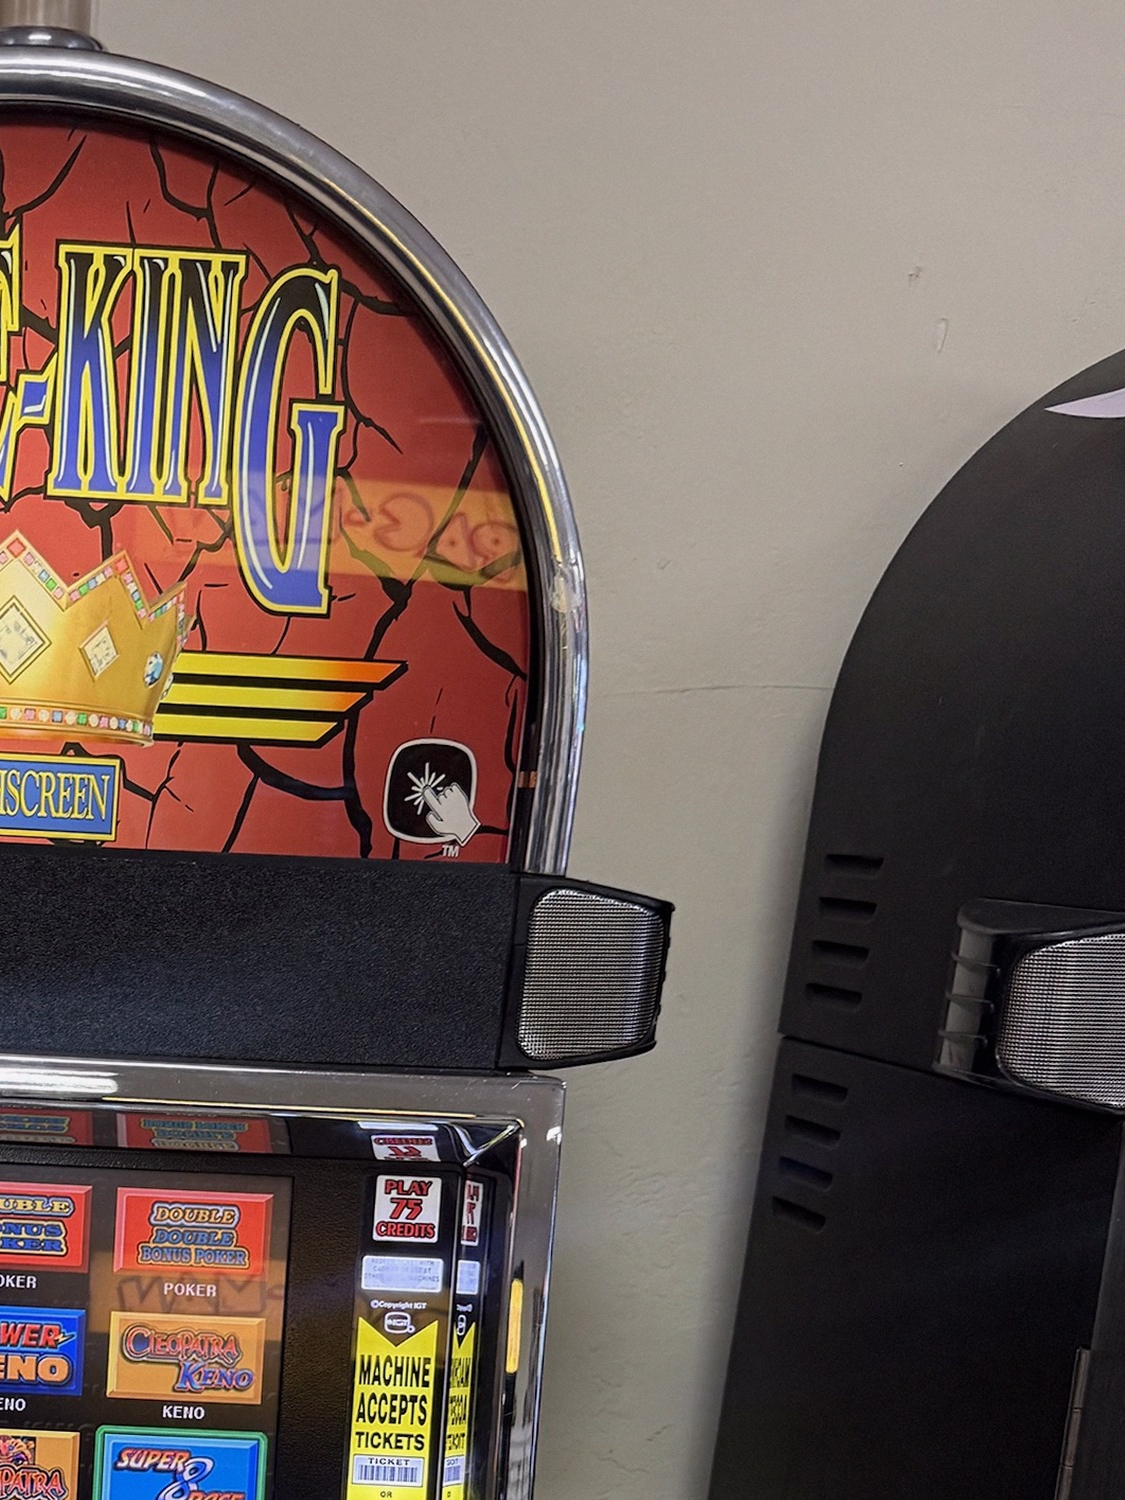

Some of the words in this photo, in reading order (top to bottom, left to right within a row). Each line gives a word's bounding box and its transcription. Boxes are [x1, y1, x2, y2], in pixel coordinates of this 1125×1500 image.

[384, 1180, 433, 1195] PLAY
[154, 1206, 235, 1224] DOUBLE
[390, 1198, 423, 1220] 75
[154, 1229, 234, 1246] DOUBLE
[375, 1221, 435, 1239] CREDITS
[141, 1245, 191, 1262] BONUS
[195, 1249, 246, 1265] POKER
[163, 1282, 217, 1297] POKER
[123, 1324, 241, 1362] CLEOPATRA
[176, 1361, 254, 1392] KENO
[359, 1354, 431, 1388] MACHINE
[162, 1405, 205, 1419] KENO
[356, 1391, 427, 1425] ACCEPTS
[355, 1431, 425, 1451] TICKETS
[115, 1448, 190, 1472] SUPER
[367, 1457, 410, 1466] TICKET
